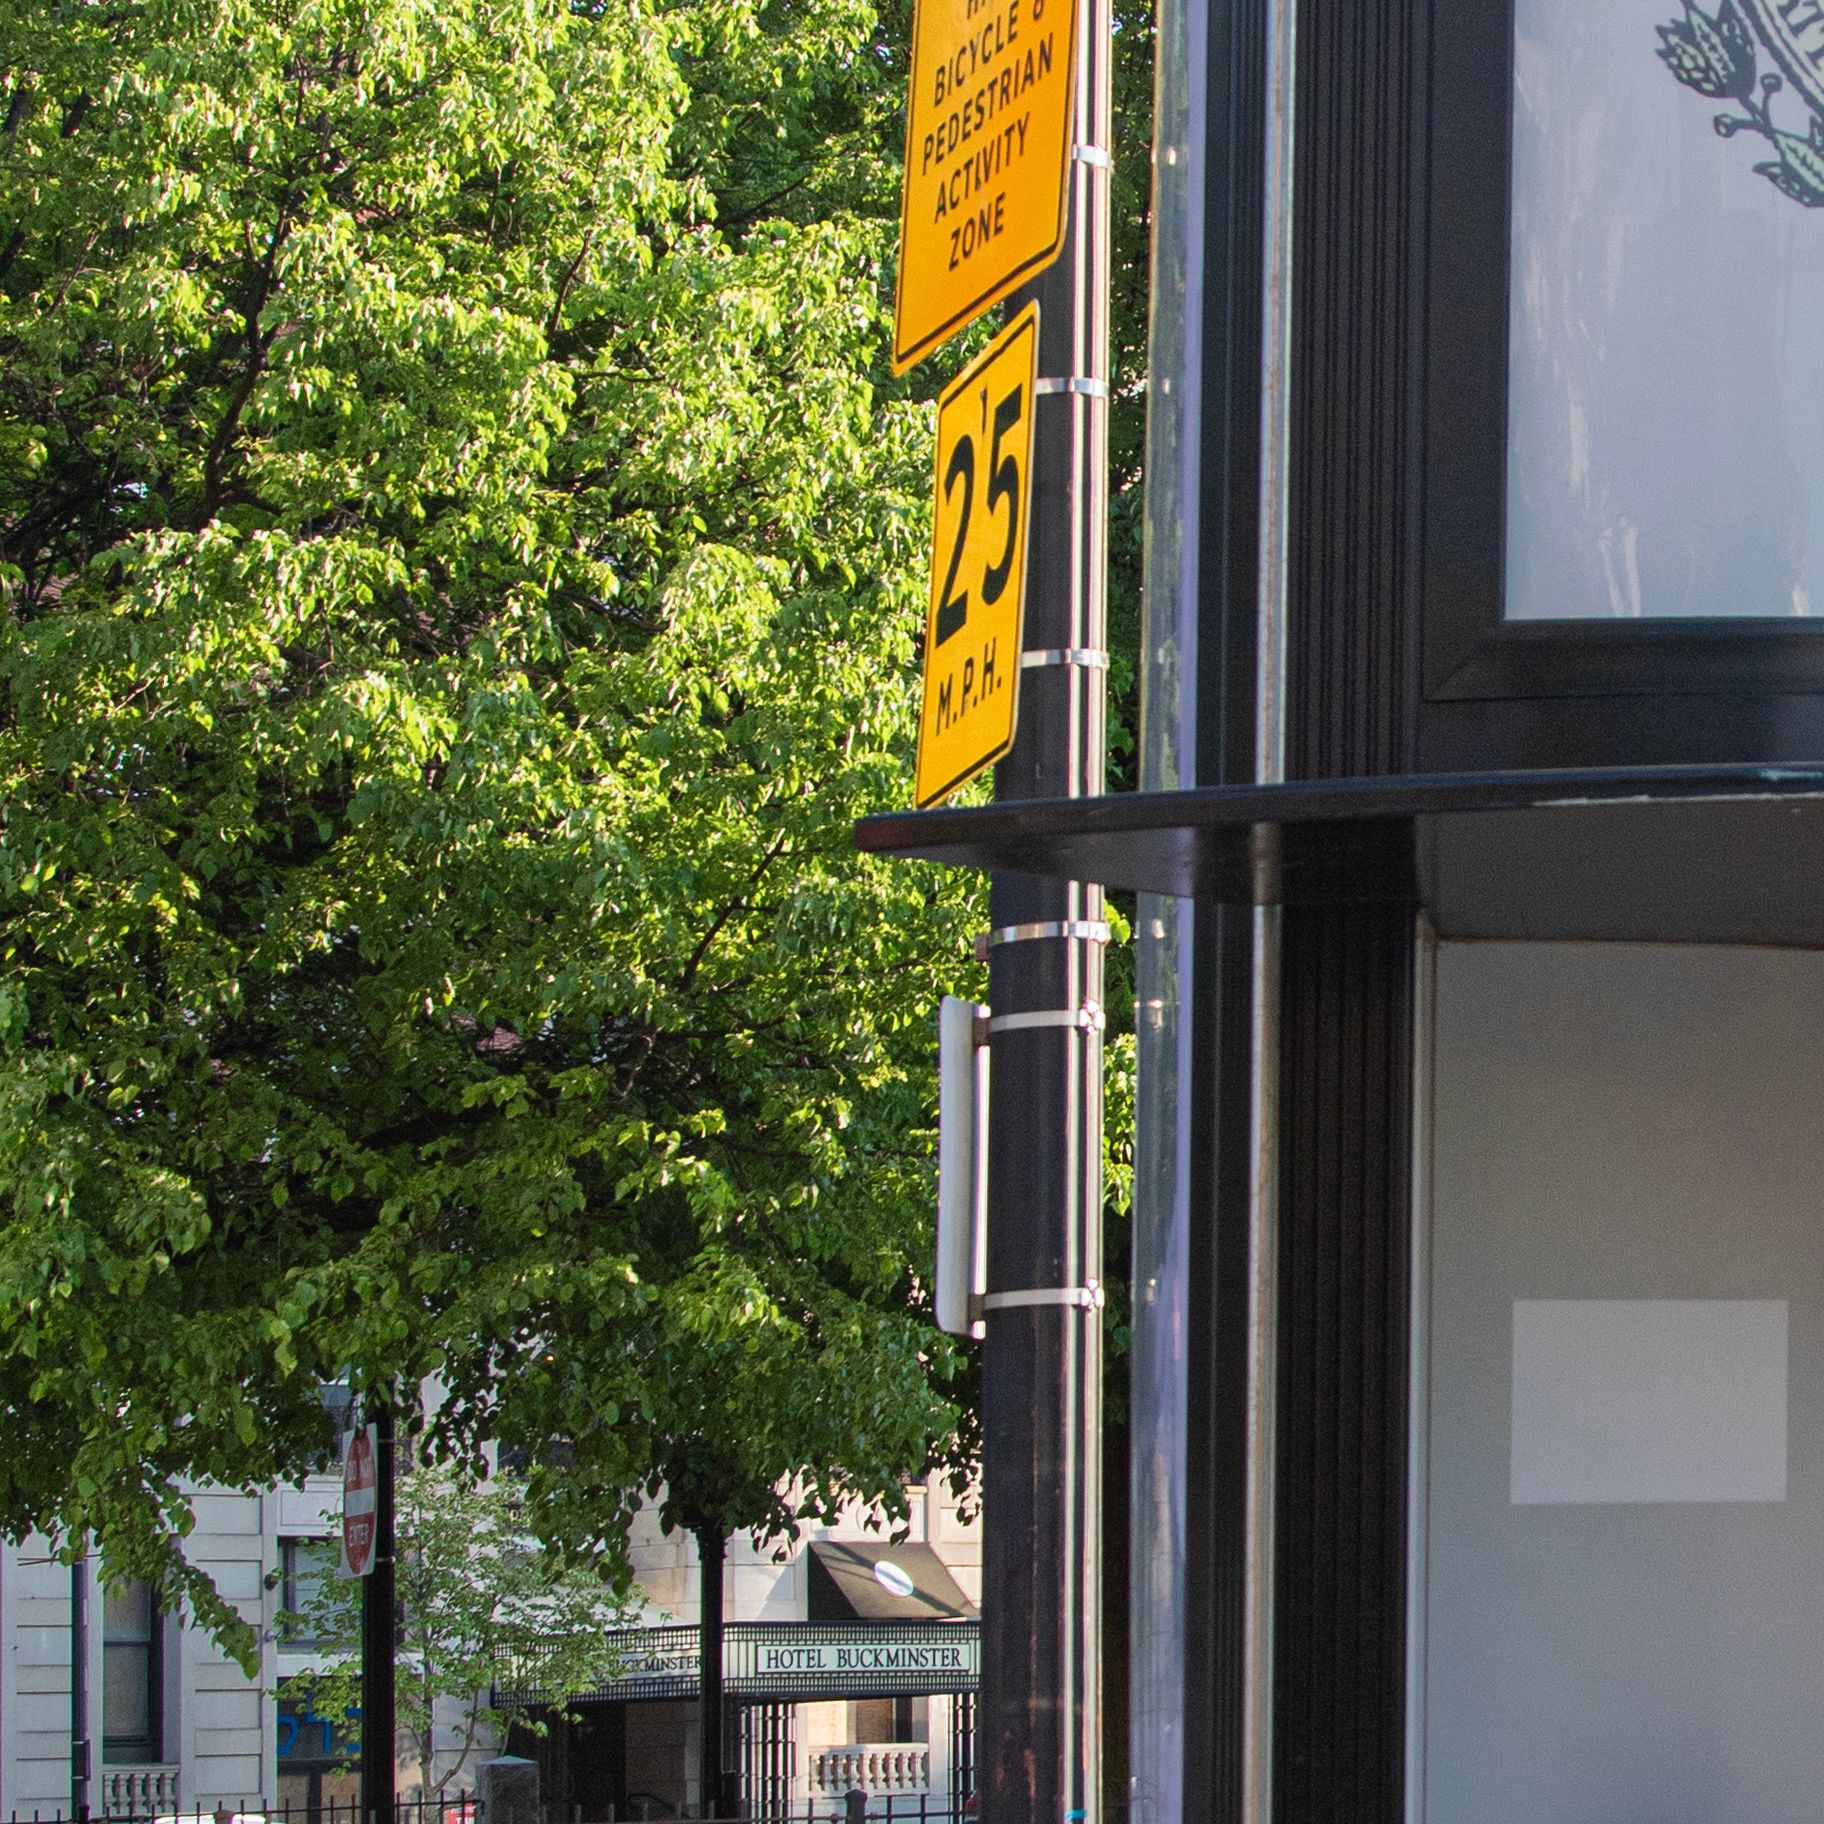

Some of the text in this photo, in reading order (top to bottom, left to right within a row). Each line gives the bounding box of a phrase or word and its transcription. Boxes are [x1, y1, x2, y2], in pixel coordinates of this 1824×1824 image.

[922, 32, 1054, 176] PEDESTRIAN
[934, 0, 1018, 108] BICYCLE
[934, 112, 1031, 224] ACTIVITY
[949, 192, 1005, 271] ZONE
[935, 383, 1023, 649] 25
[936, 636, 1003, 736] M.P.H.
[616, 1654, 702, 1674] UCKMINSTER
[765, 1645, 963, 1671] HOTEL BUCKMINSTER
